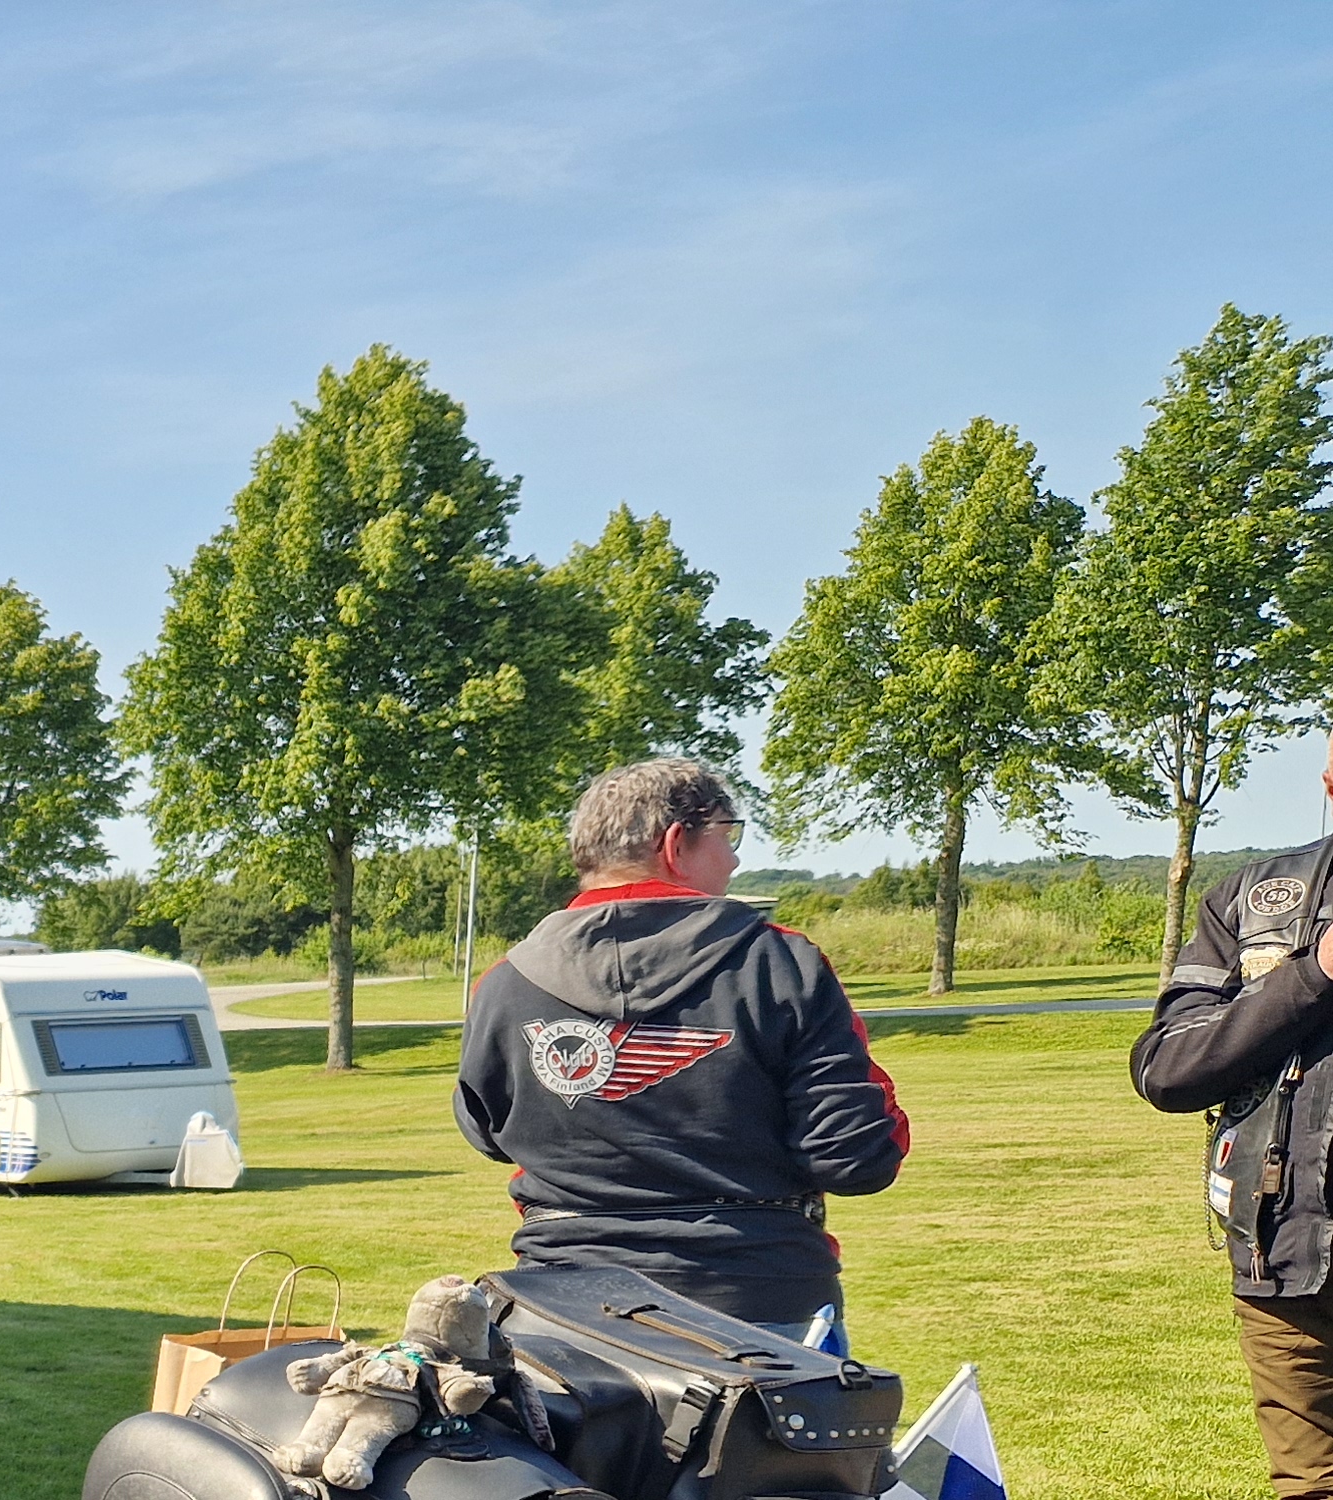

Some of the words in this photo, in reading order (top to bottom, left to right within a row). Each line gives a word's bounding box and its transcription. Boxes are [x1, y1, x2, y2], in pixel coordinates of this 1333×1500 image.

[98, 989, 128, 1001] Polar
[535, 1025, 567, 1079] YAMAHA
[573, 1024, 613, 1078] CUSTOM
[551, 1047, 593, 1069] Club
[550, 1077, 597, 1092] Finland
